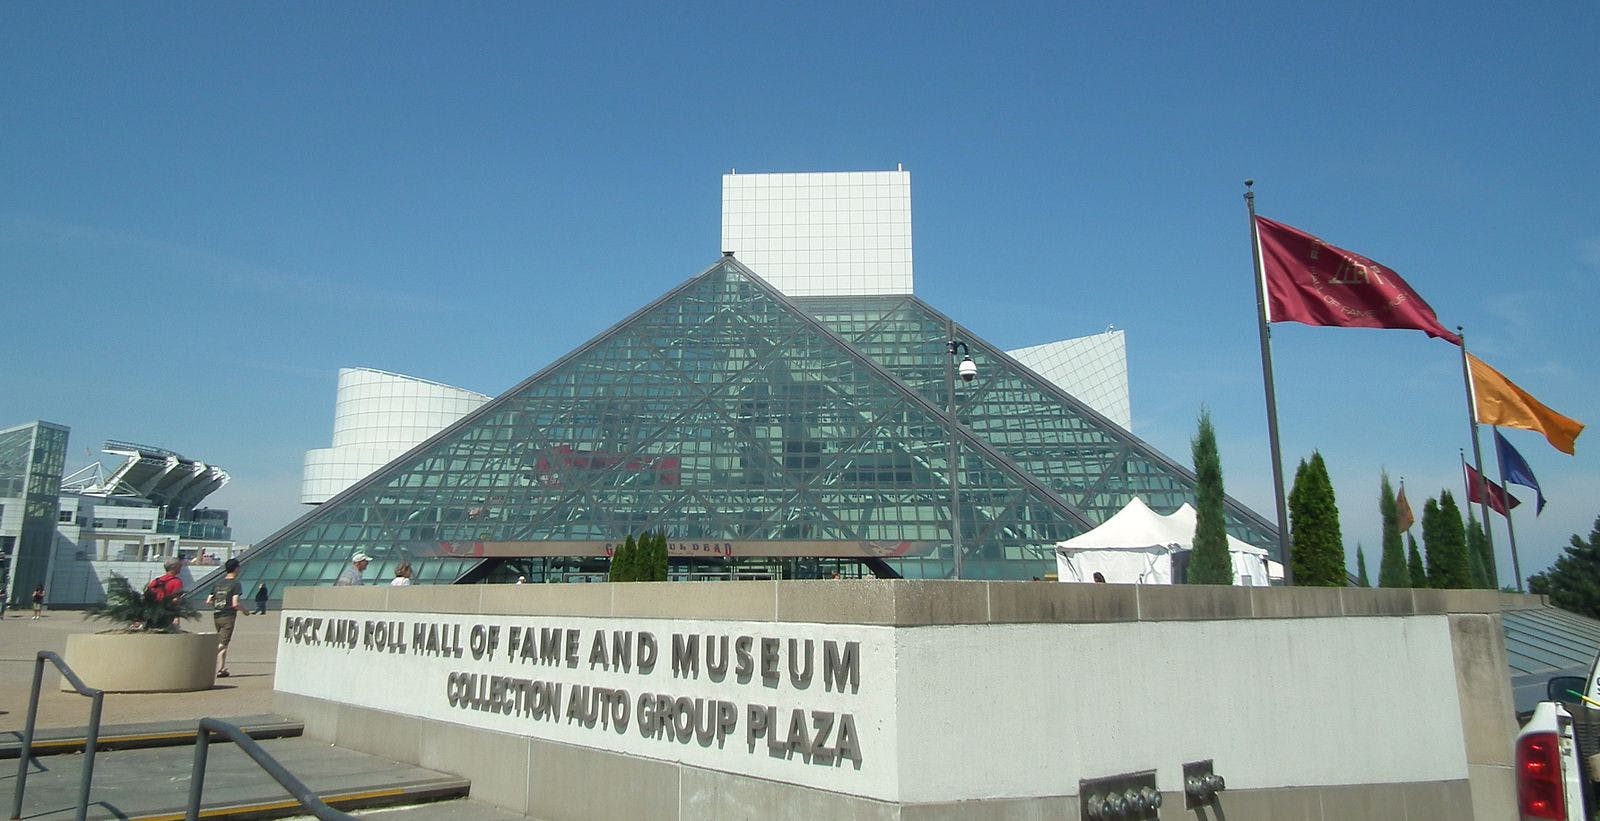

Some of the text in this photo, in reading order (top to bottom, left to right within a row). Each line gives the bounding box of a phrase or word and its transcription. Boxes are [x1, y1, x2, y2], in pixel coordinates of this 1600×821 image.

[284, 617, 861, 694] ROCK AND ROLL HALL OF FAME AND MUSEUM
[447, 671, 863, 770] COLLECTION AUTO GROUP PLAZA
